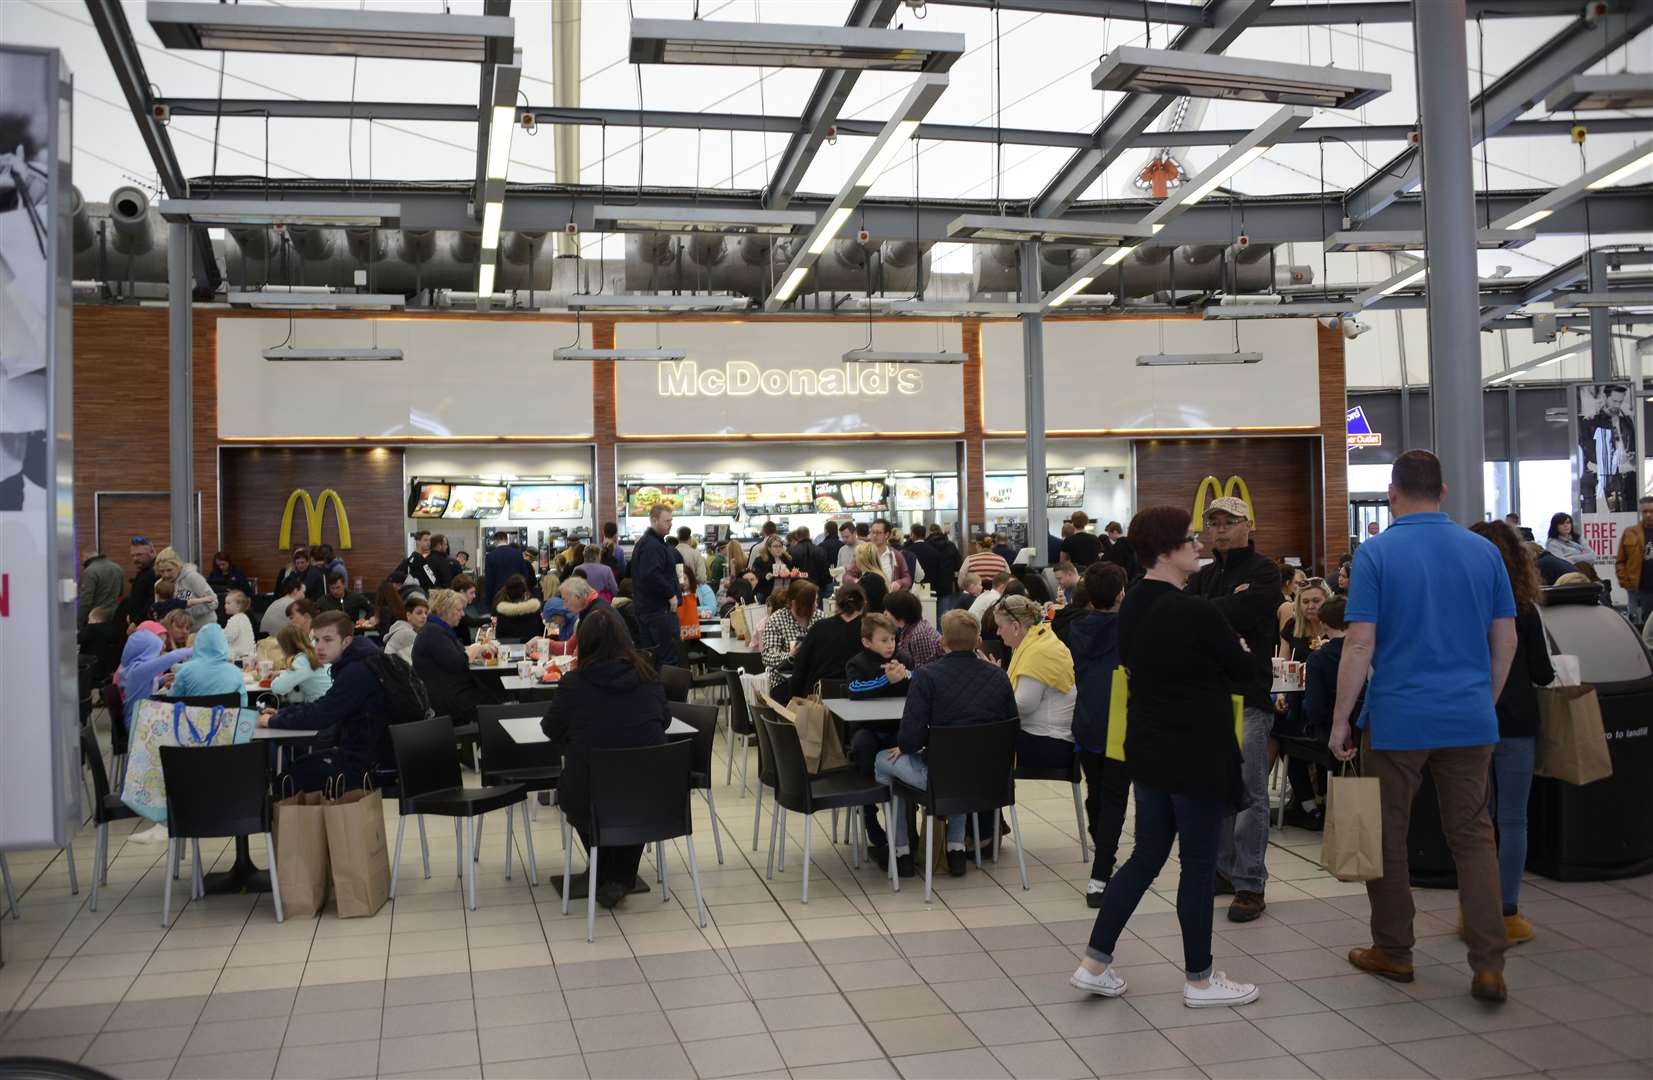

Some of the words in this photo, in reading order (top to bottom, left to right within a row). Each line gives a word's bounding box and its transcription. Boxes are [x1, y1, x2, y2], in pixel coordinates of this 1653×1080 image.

[659, 360, 923, 396] McDonald's
[1357, 435, 1379, 444] Outlet
[1583, 523, 1617, 539] FREE
[1615, 730, 1624, 739] to
[1625, 726, 1649, 738] landfill
